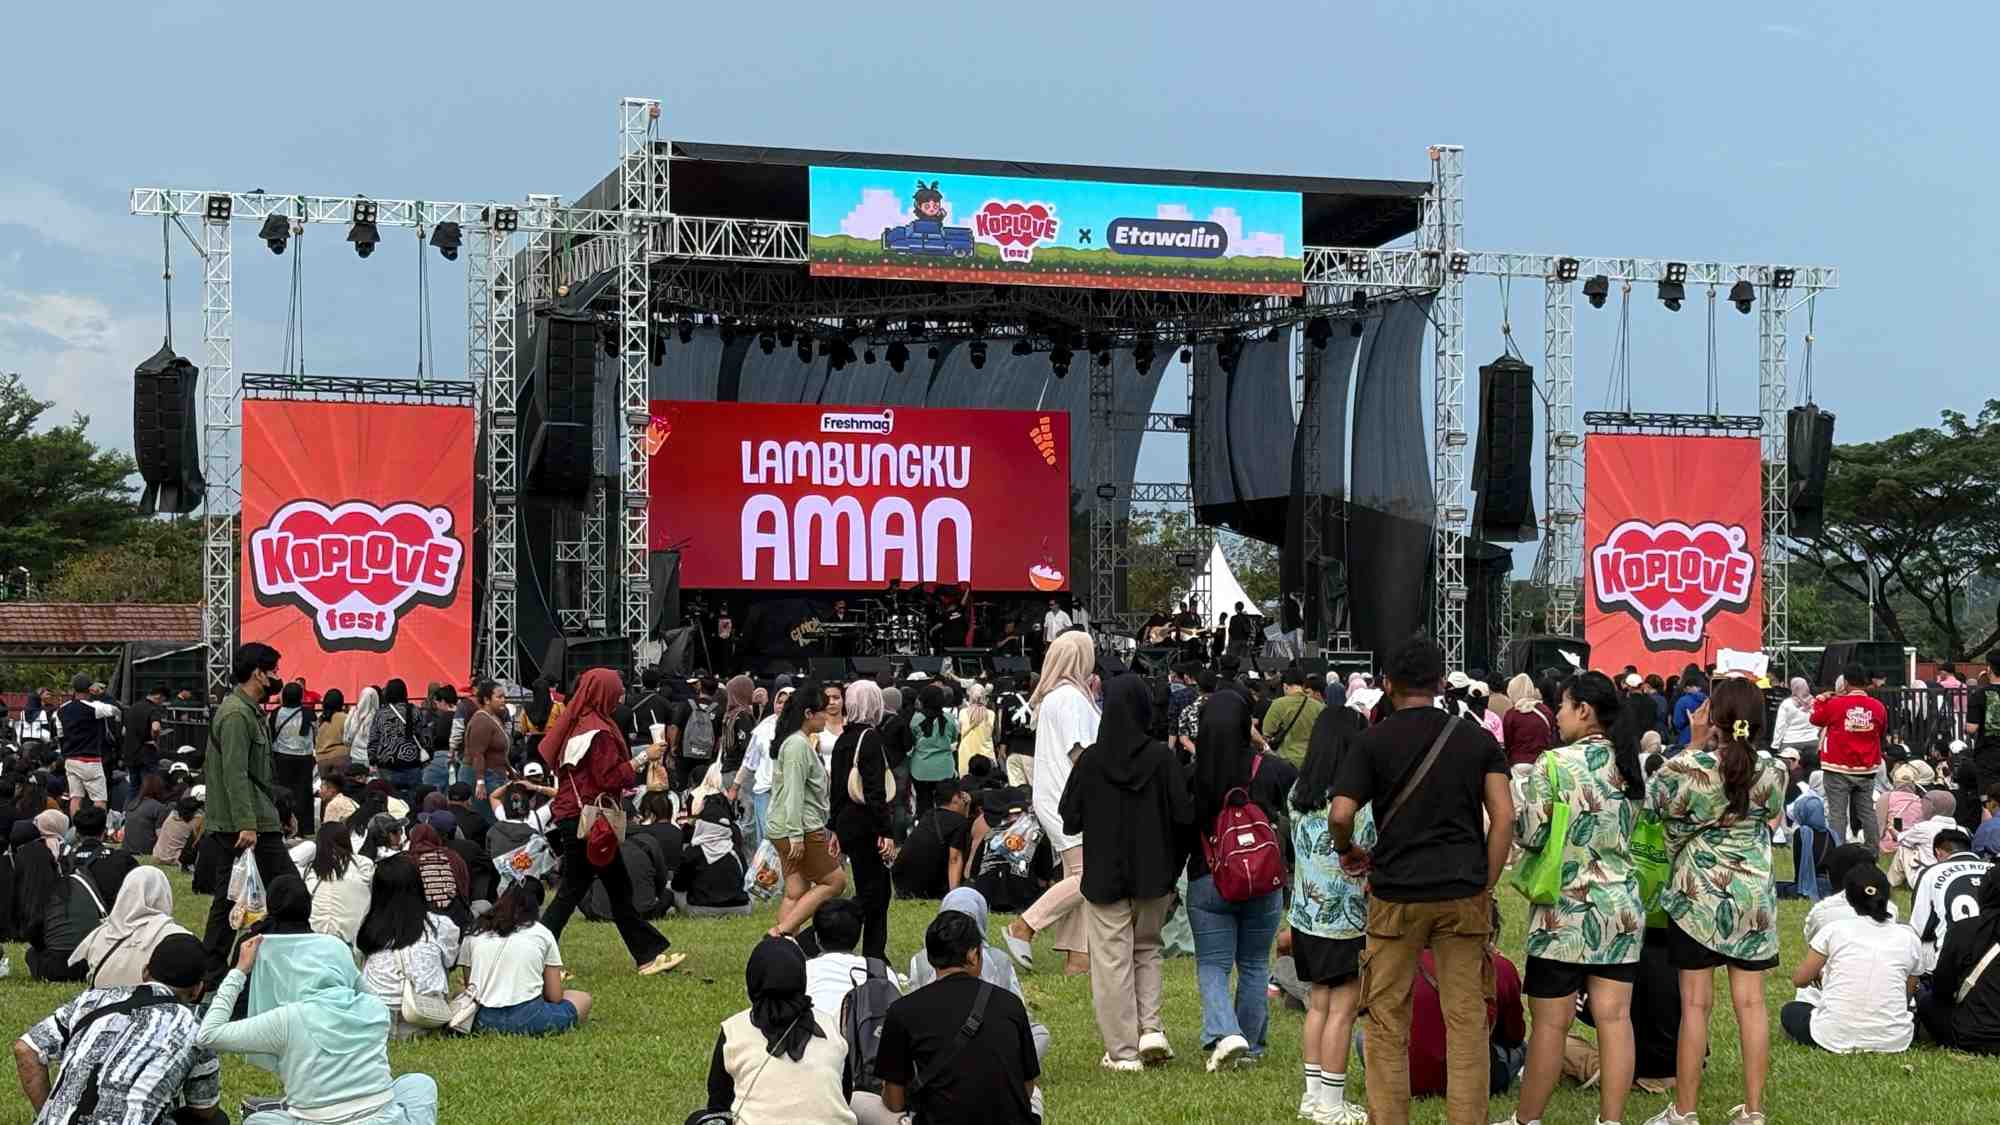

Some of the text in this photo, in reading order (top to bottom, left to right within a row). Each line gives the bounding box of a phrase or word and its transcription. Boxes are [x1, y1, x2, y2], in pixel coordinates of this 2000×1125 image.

[976, 213, 1057, 239] KOPLOVE
[1115, 226, 1220, 249] Etawalin
[1003, 247, 1029, 259] fest
[824, 416, 891, 434] Freshmag
[741, 440, 971, 489] LAMBUNGKU
[741, 494, 972, 582] AMAN
[260, 535, 454, 587] KOPLOVE
[1600, 550, 1747, 597] KOPLOVE
[325, 608, 387, 632] fest
[1649, 614, 1697, 634] fest
[1934, 864, 1967, 890] ROCKET
